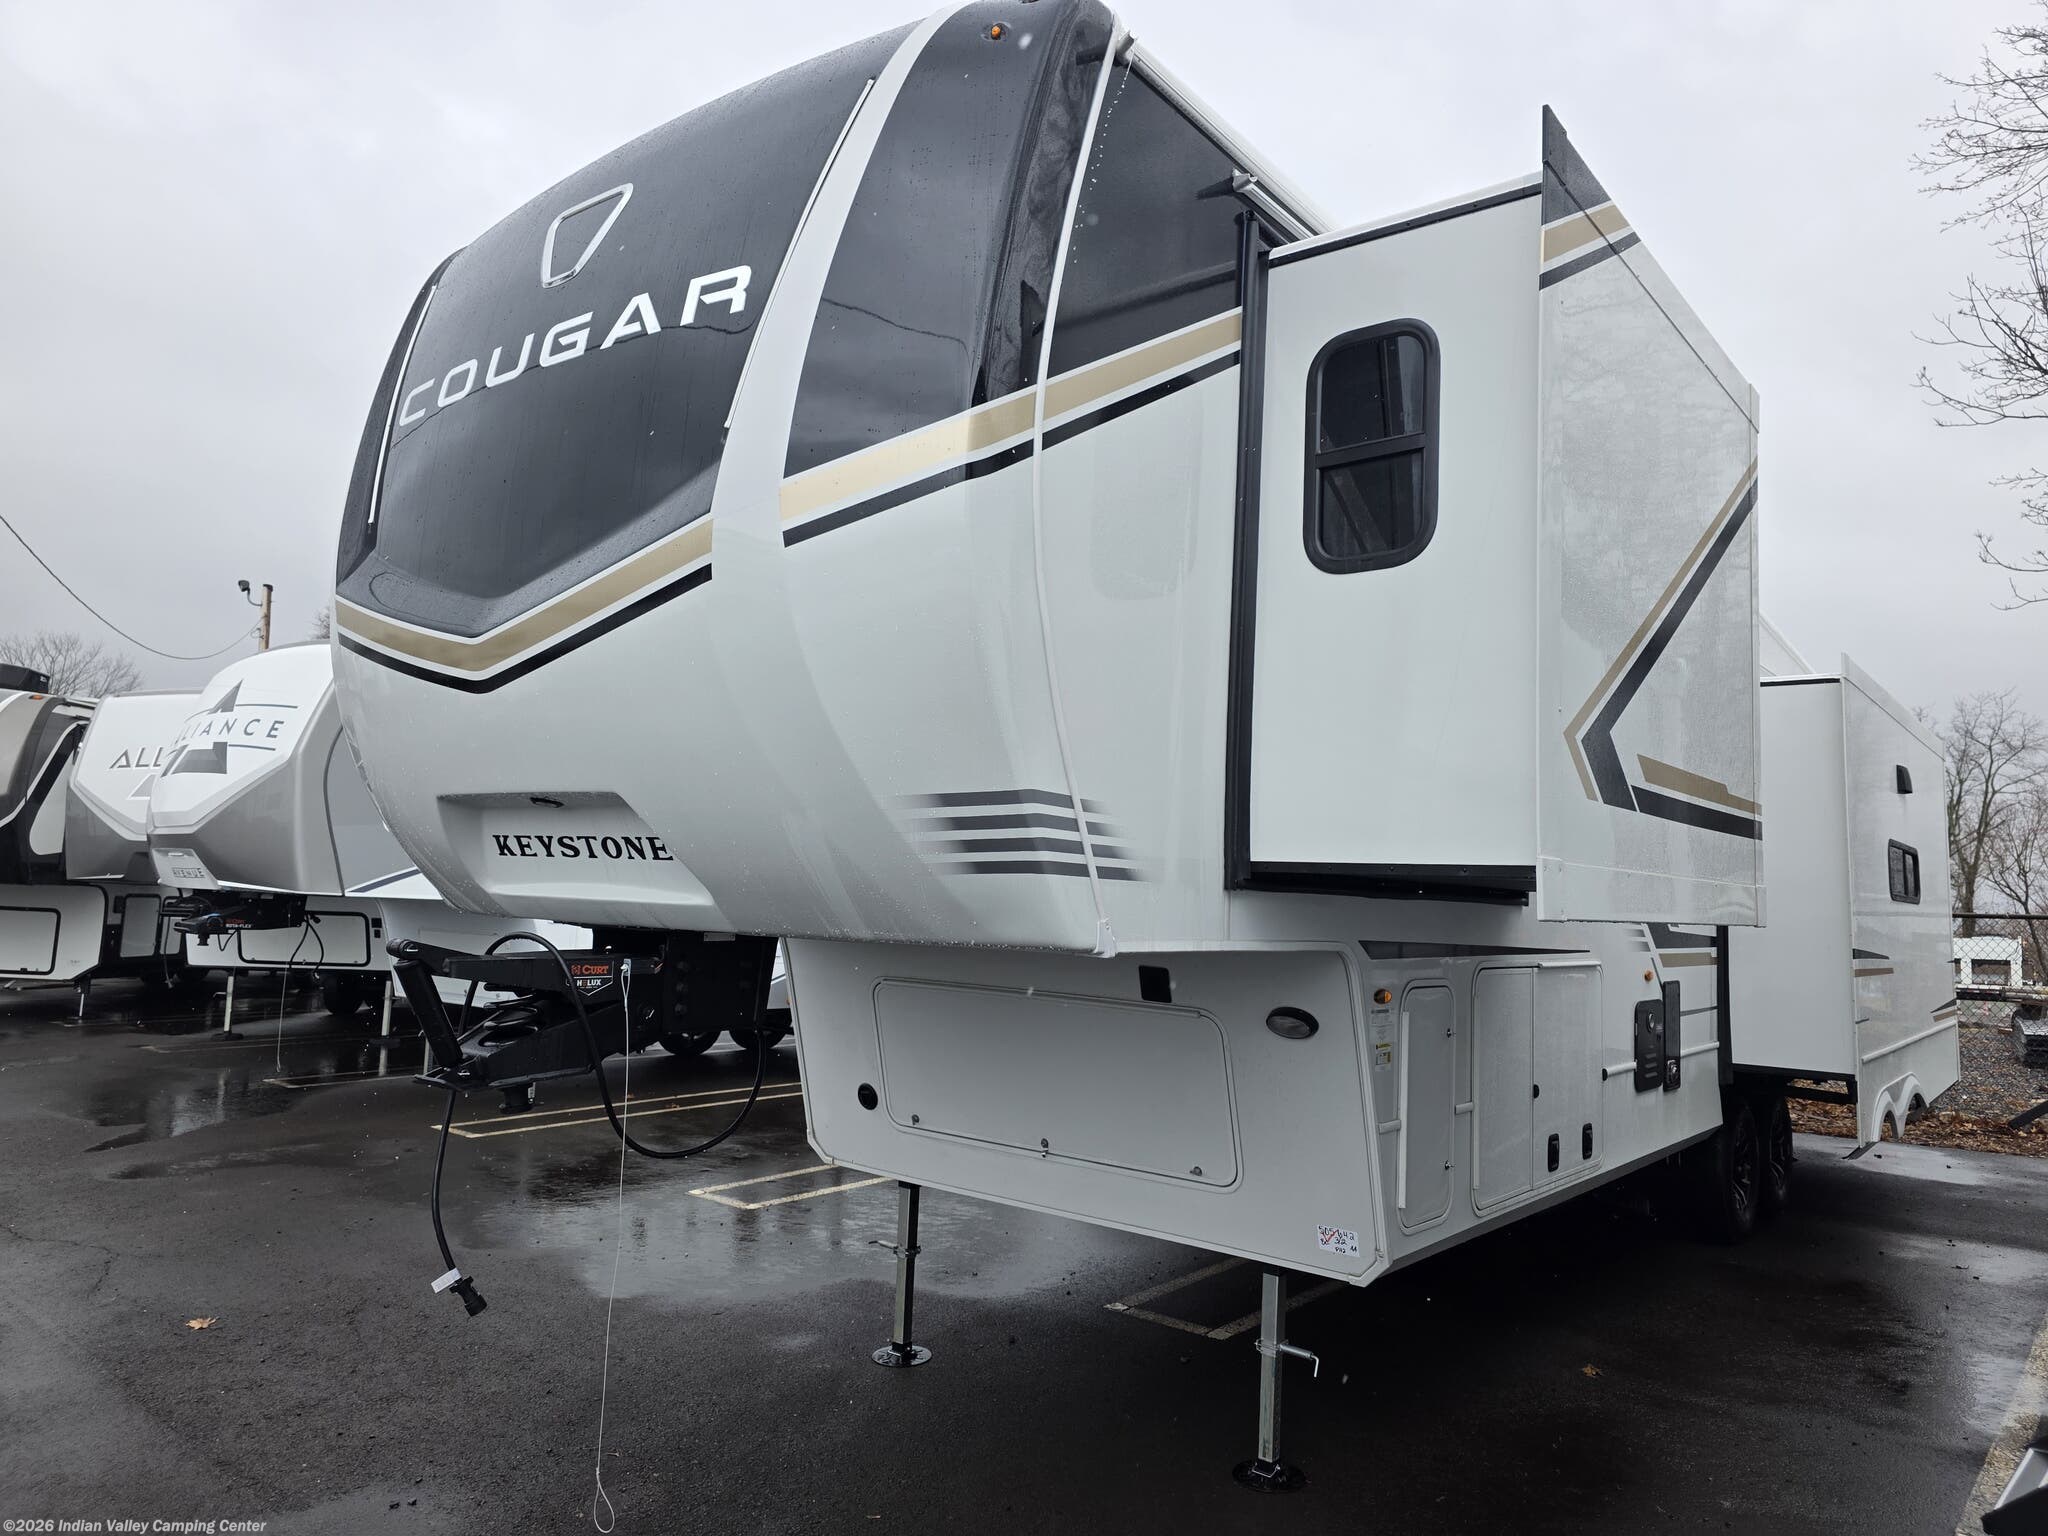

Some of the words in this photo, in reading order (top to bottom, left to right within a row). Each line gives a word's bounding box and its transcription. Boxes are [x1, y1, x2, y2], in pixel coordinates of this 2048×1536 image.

[399, 264, 752, 427] COUGAR
[492, 834, 674, 861] KEYSTONE
[582, 964, 609, 974] CURT
[576, 979, 602, 987] HELUX
